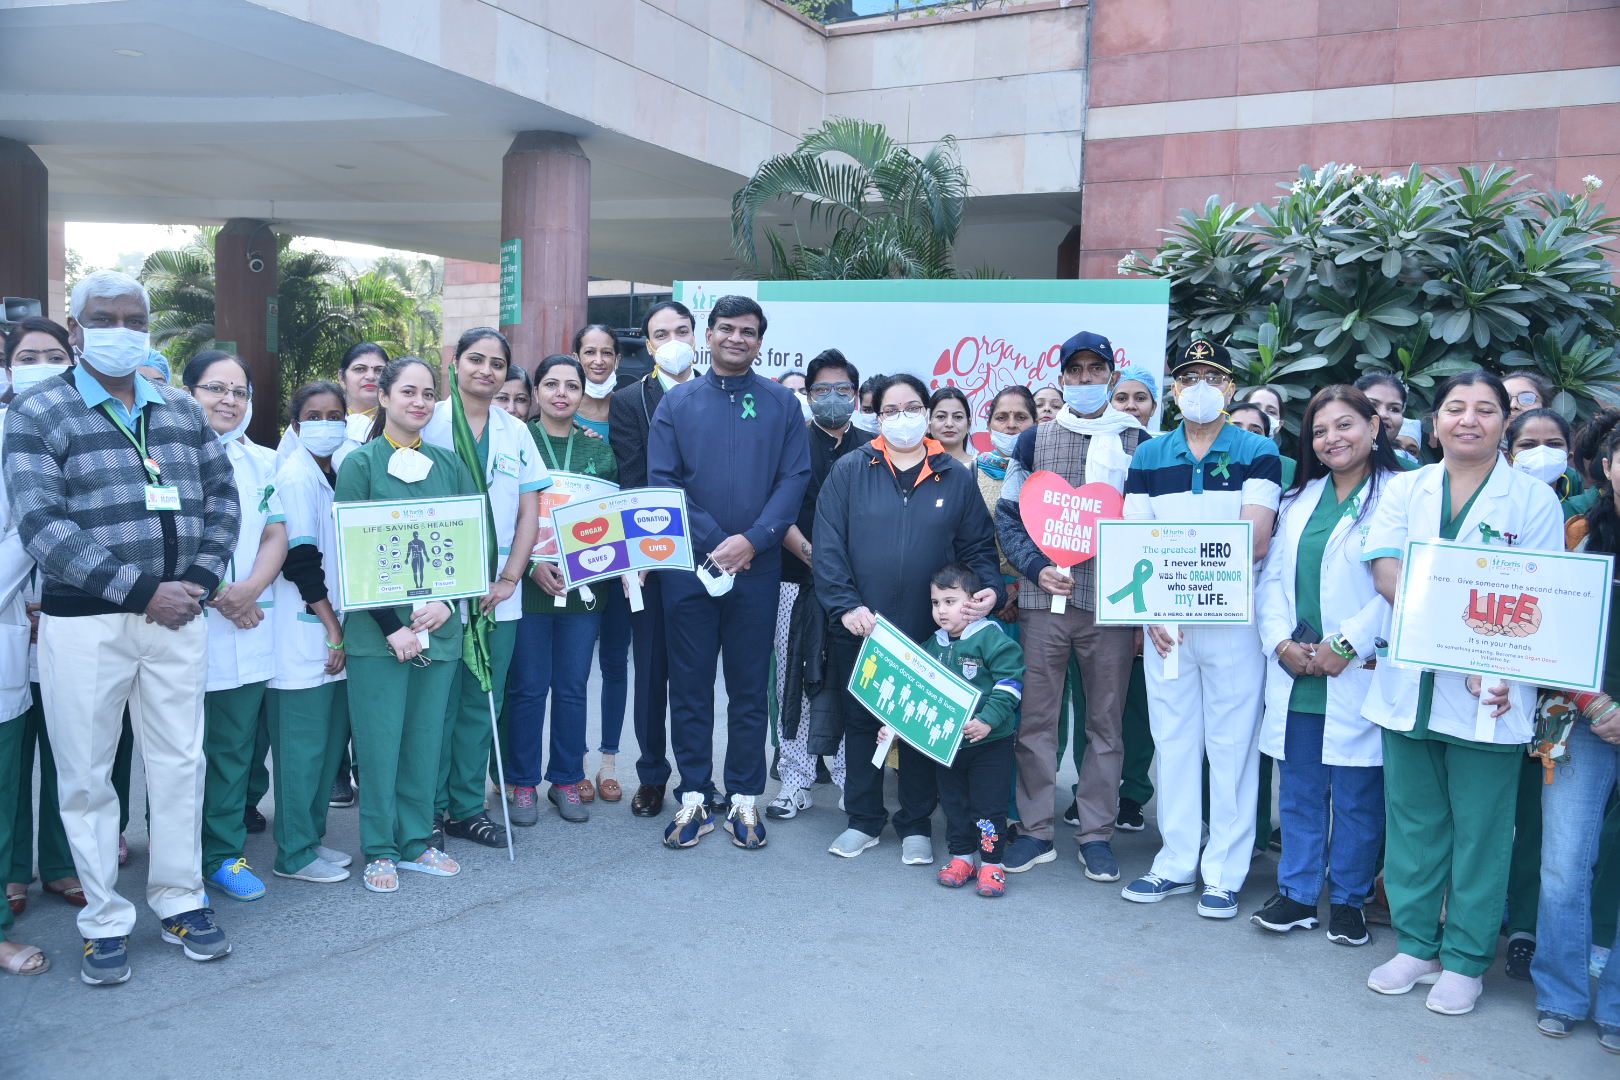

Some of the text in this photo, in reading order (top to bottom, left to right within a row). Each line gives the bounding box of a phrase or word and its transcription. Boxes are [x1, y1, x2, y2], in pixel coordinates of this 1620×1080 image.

[767, 347, 790, 367] for
[794, 352, 803, 368] a
[1043, 489, 1102, 514] BECOME
[636, 515, 669, 524] DONATION
[1060, 507, 1080, 523] AN
[363, 526, 382, 534] LIFE
[385, 523, 420, 532] SAVING
[427, 520, 464, 529] HEALING
[580, 526, 603, 537] ORGAN
[1045, 518, 1092, 540] ORGAN
[648, 544, 667, 552] LIVES
[1042, 531, 1091, 554] DONOR
[1143, 542, 1231, 558] The greatest HERO
[587, 554, 608, 565] SAVES
[1158, 570, 1242, 582] was the ORGAN DONOR
[1167, 582, 1213, 591] who saved
[1457, 577, 1474, 586] Give
[1475, 580, 1510, 589] someone
[1511, 583, 1524, 591] the
[1525, 585, 1553, 594] second
[1554, 588, 1581, 597] chance
[1175, 593, 1228, 608] my LIFE.
[1468, 588, 1539, 626] LIFE
[1490, 640, 1507, 648] your
[1509, 643, 1532, 651] hands
[873, 646, 885, 659] One
[884, 656, 900, 671] organ
[899, 668, 916, 683] donor
[915, 680, 926, 691] can
[925, 689, 938, 700] save
